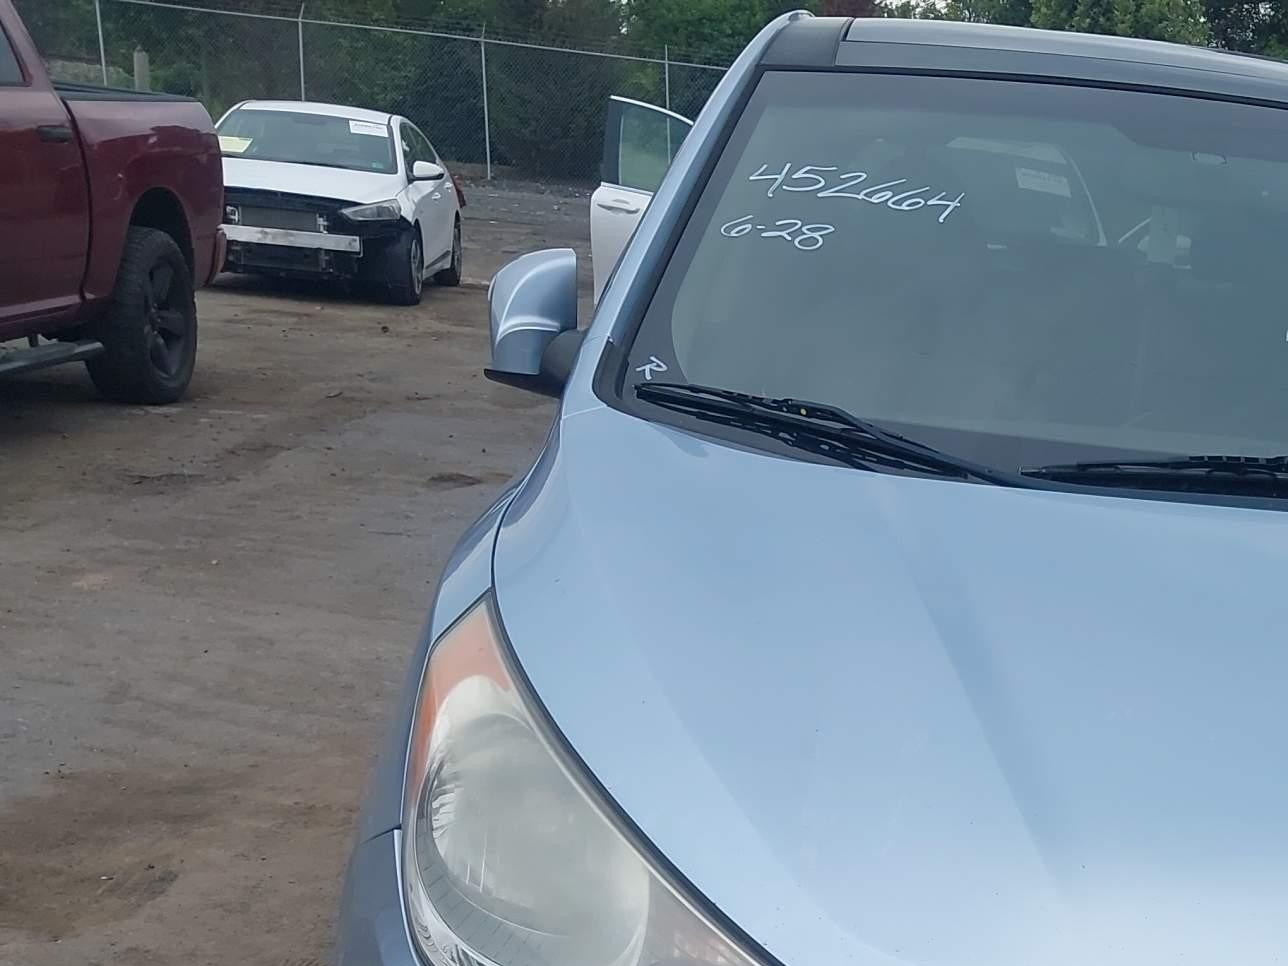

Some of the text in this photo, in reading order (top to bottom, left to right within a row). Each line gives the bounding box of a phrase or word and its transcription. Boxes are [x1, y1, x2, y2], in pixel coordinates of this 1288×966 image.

[749, 162, 965, 223] 452664
[720, 215, 835, 250] 6-28
[635, 356, 668, 380] R
